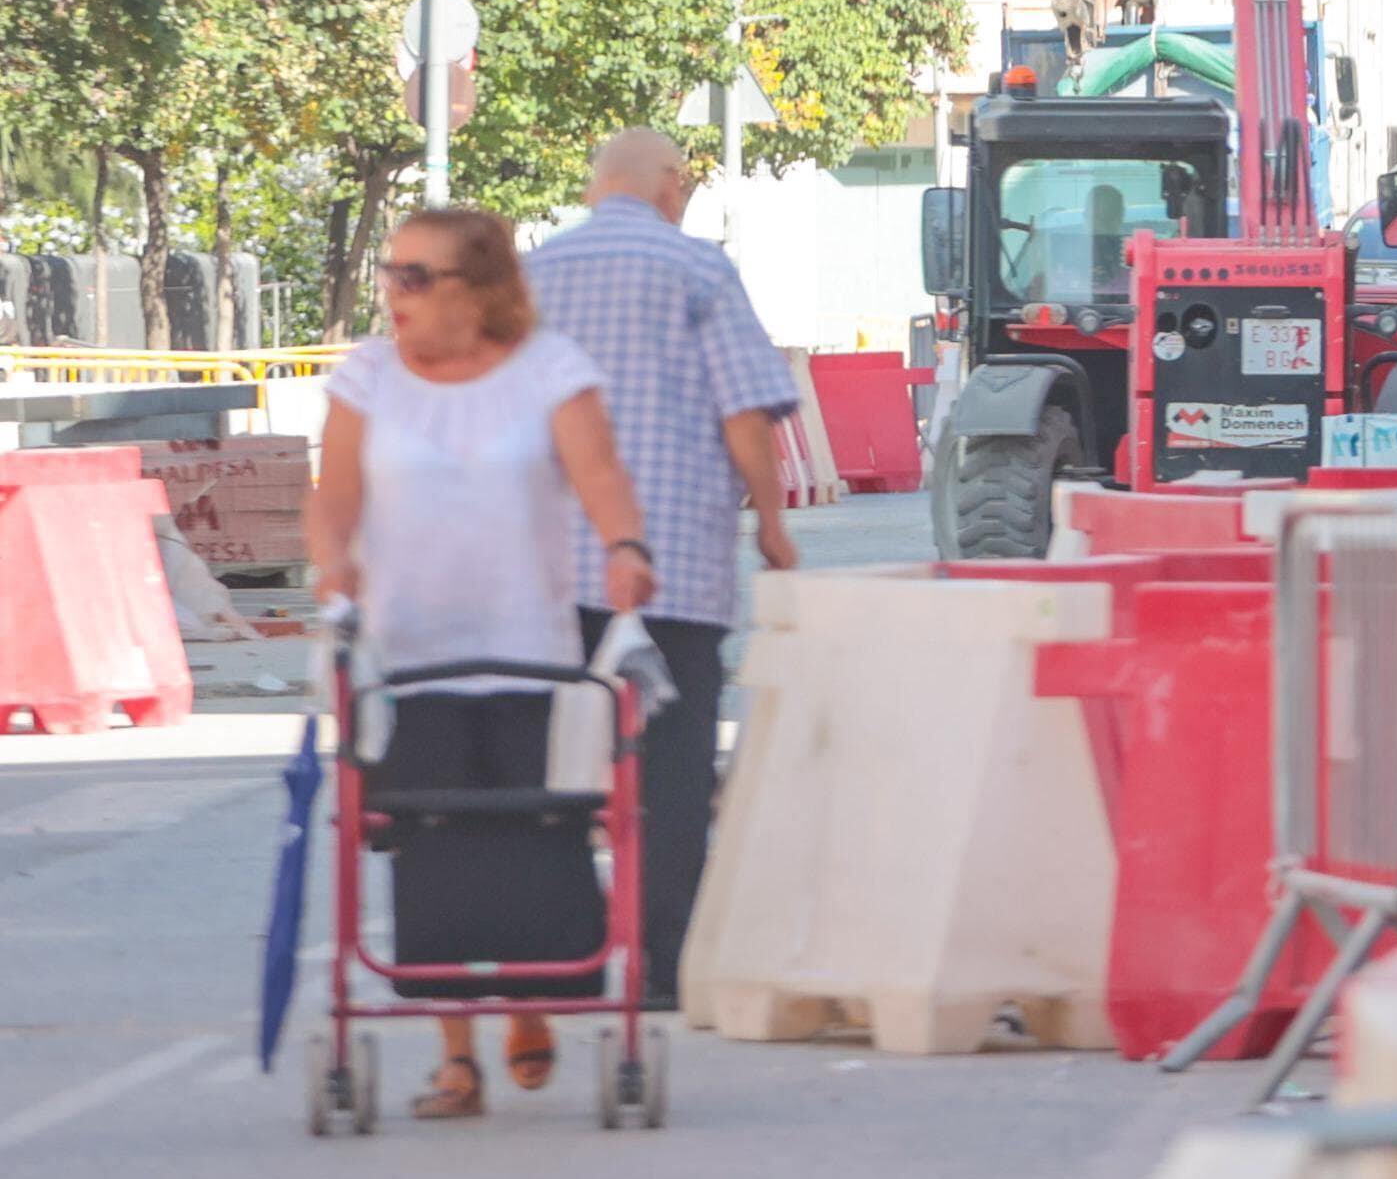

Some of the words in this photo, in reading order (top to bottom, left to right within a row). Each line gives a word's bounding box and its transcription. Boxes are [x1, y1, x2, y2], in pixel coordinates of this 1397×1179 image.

[1270, 325, 1312, 343] 337
[1221, 407, 1274, 418] Maxim
[1221, 418, 1305, 430] Domenech
